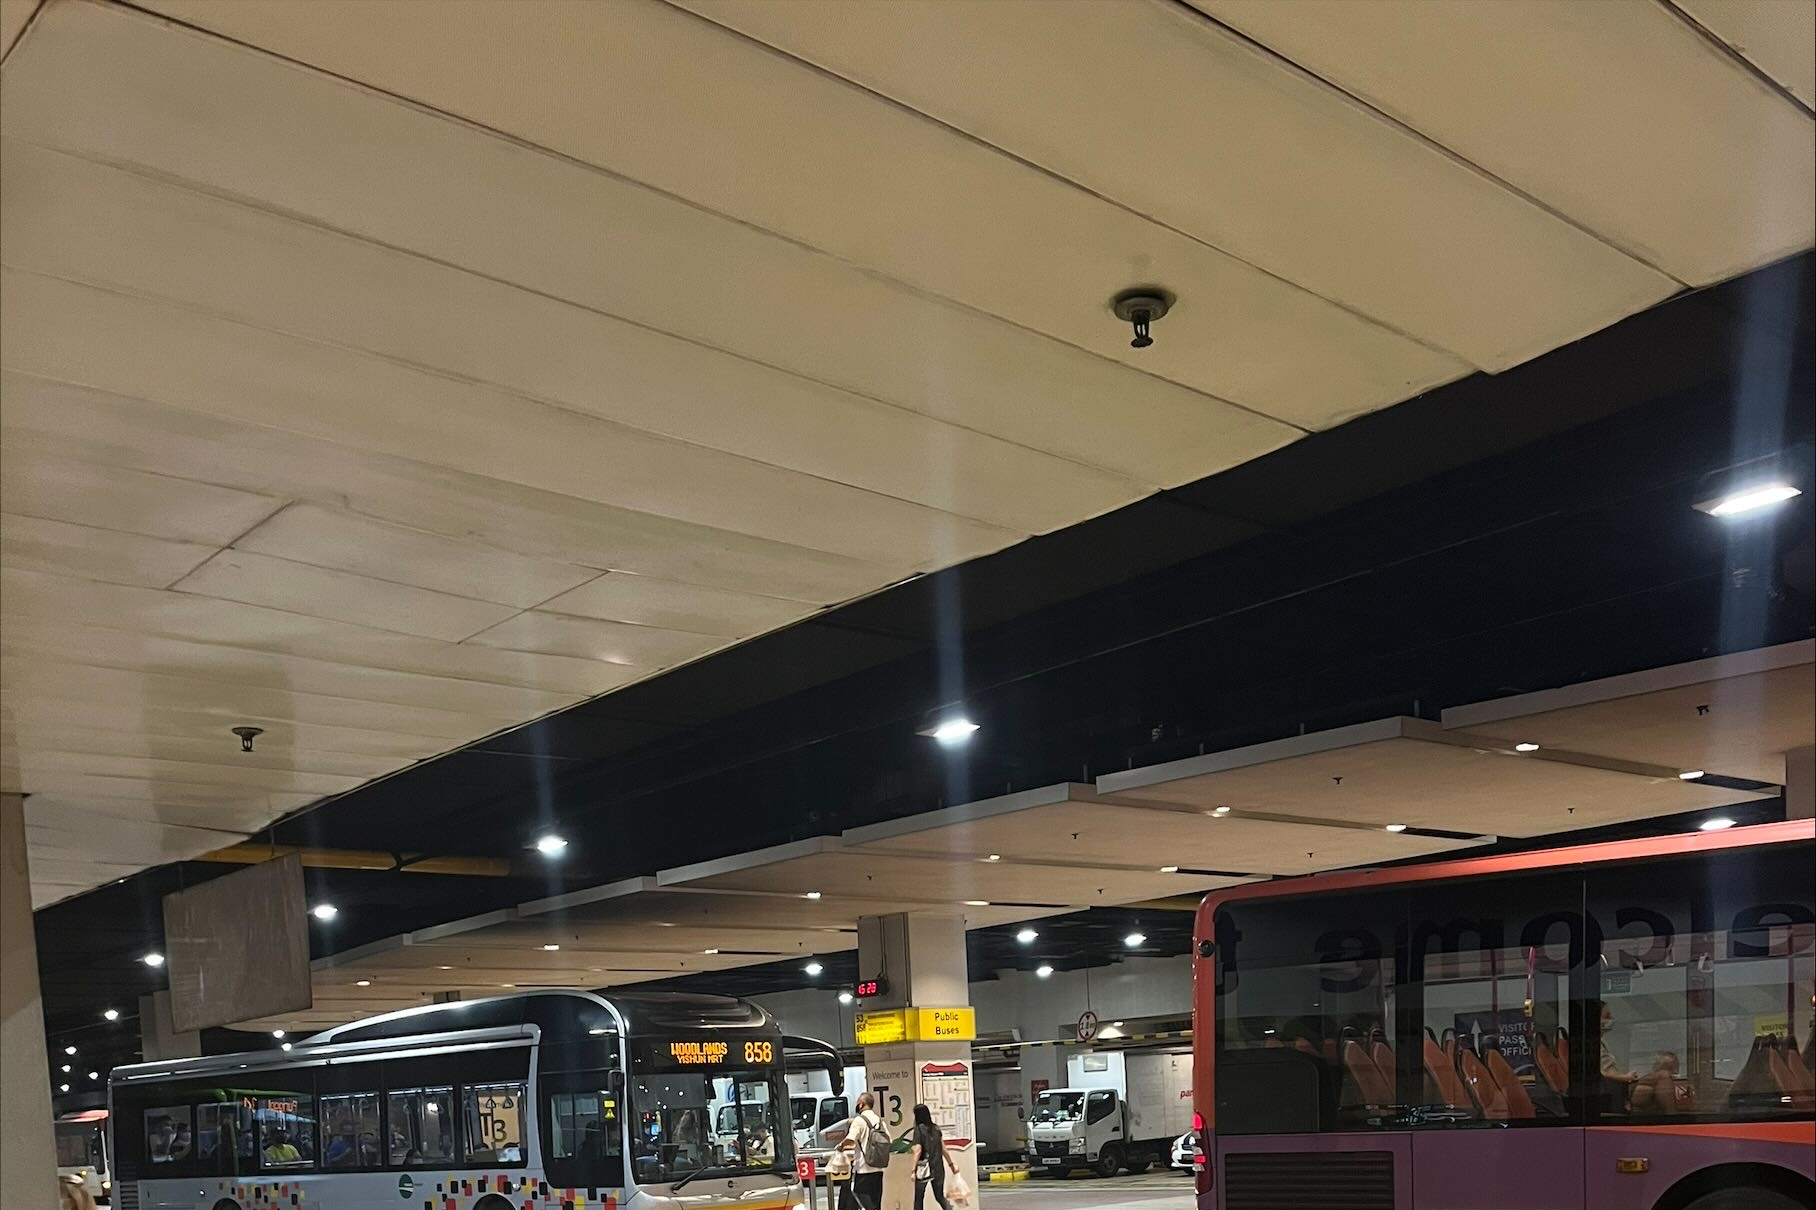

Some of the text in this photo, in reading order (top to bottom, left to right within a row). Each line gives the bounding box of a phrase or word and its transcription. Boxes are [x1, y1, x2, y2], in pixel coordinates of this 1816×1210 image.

[934, 1012, 959, 1021] Public
[935, 1026, 960, 1035] Buses
[670, 1041, 773, 1063] WOODLANDS 858
[677, 1054, 724, 1065] YISHUN MRT
[872, 1070, 909, 1080] Welcome to
[873, 1085, 903, 1127] T3
[799, 1161, 809, 1176] 3
